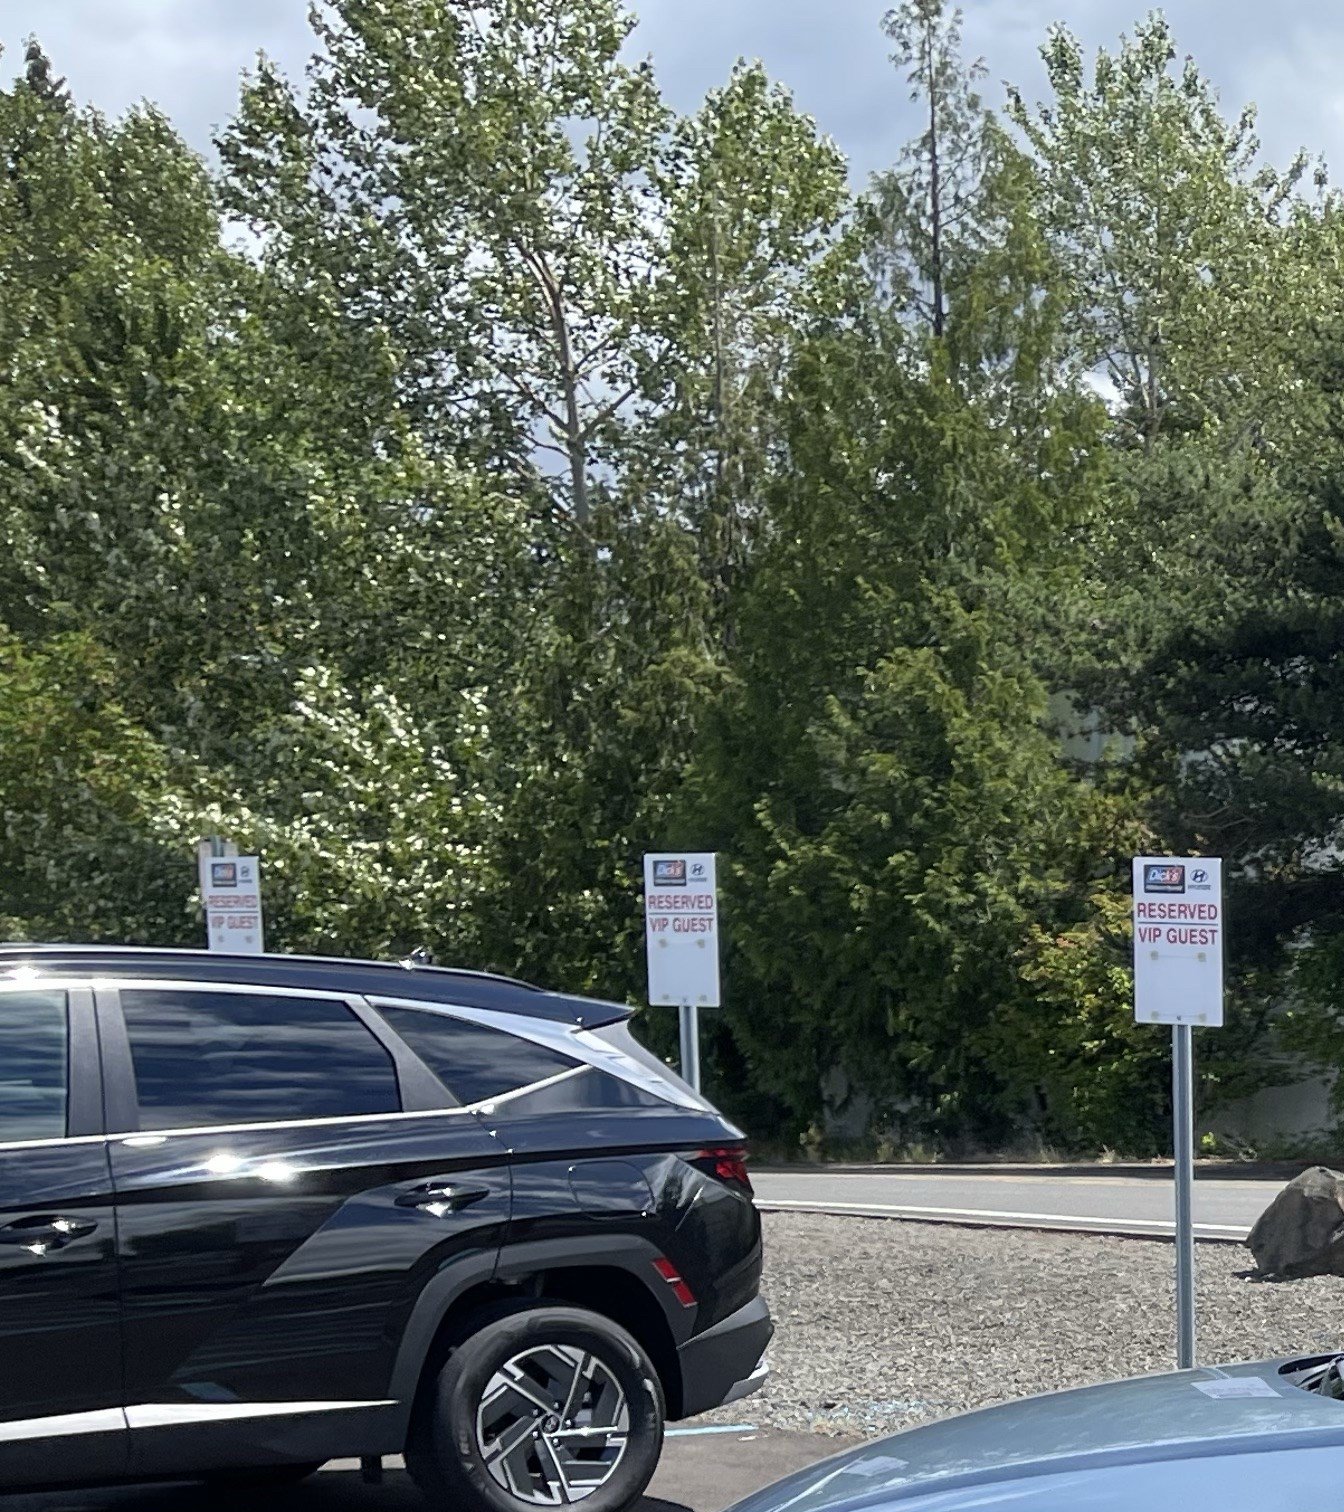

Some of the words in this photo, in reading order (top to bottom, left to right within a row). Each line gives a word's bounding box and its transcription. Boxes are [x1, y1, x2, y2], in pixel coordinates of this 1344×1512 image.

[648, 894, 714, 909] RESERVED
[1137, 902, 1218, 920] RESERVED
[649, 917, 669, 932] VIP
[672, 917, 714, 933] GUEST
[1138, 927, 1162, 944] VIP
[1166, 928, 1218, 945] GUEST
